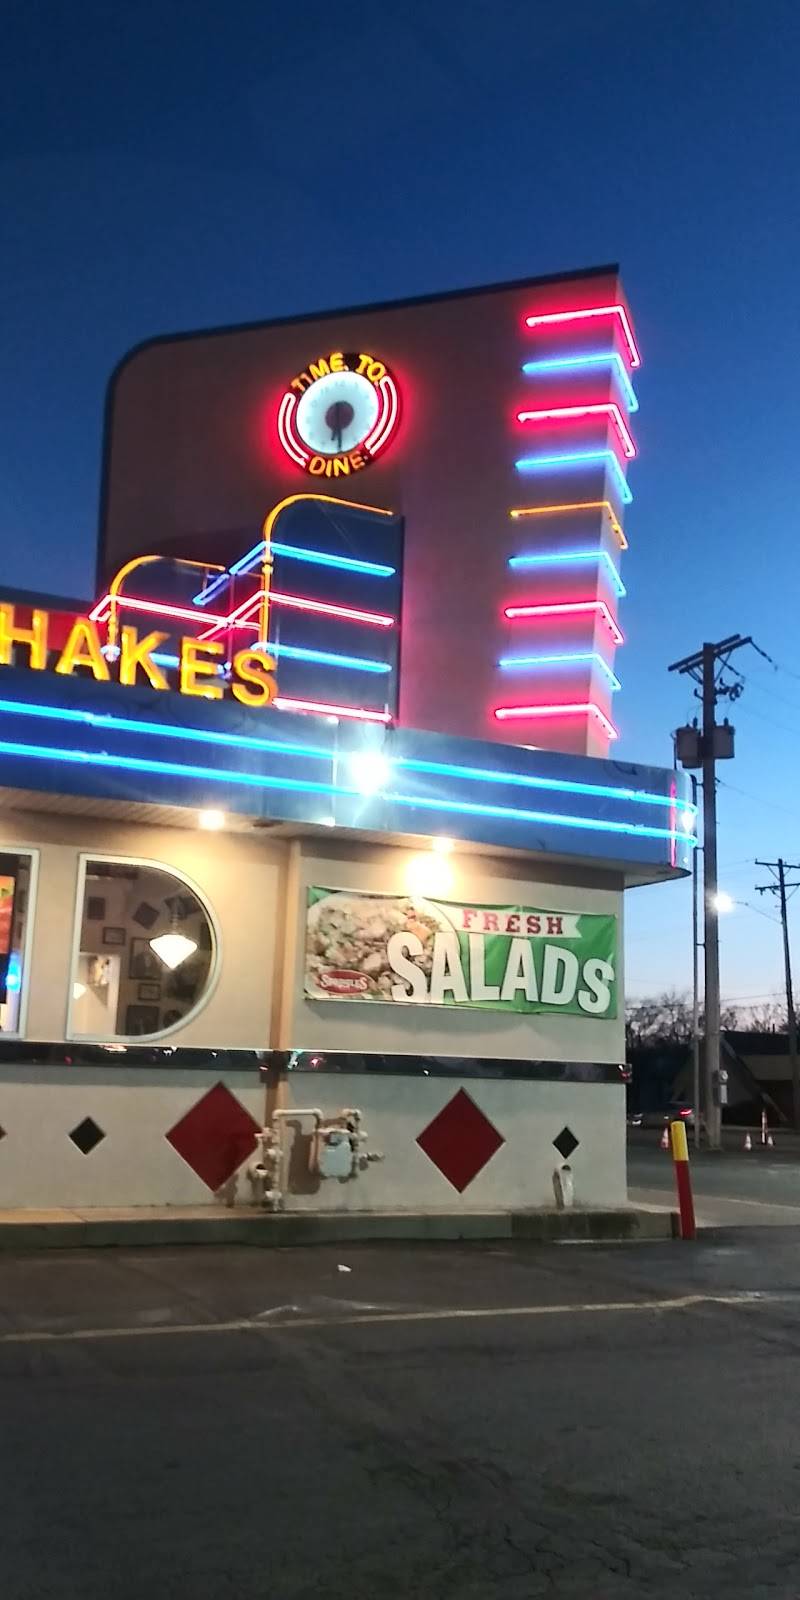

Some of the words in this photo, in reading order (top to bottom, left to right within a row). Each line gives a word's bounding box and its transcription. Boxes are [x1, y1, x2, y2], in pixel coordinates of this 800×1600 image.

[290, 352, 344, 392] TIME
[355, 353, 386, 382] TO
[308, 451, 365, 477] DINE
[0, 603, 278, 706] HAKES
[462, 908, 564, 935] FRESH
[387, 931, 615, 1013] SALADS
